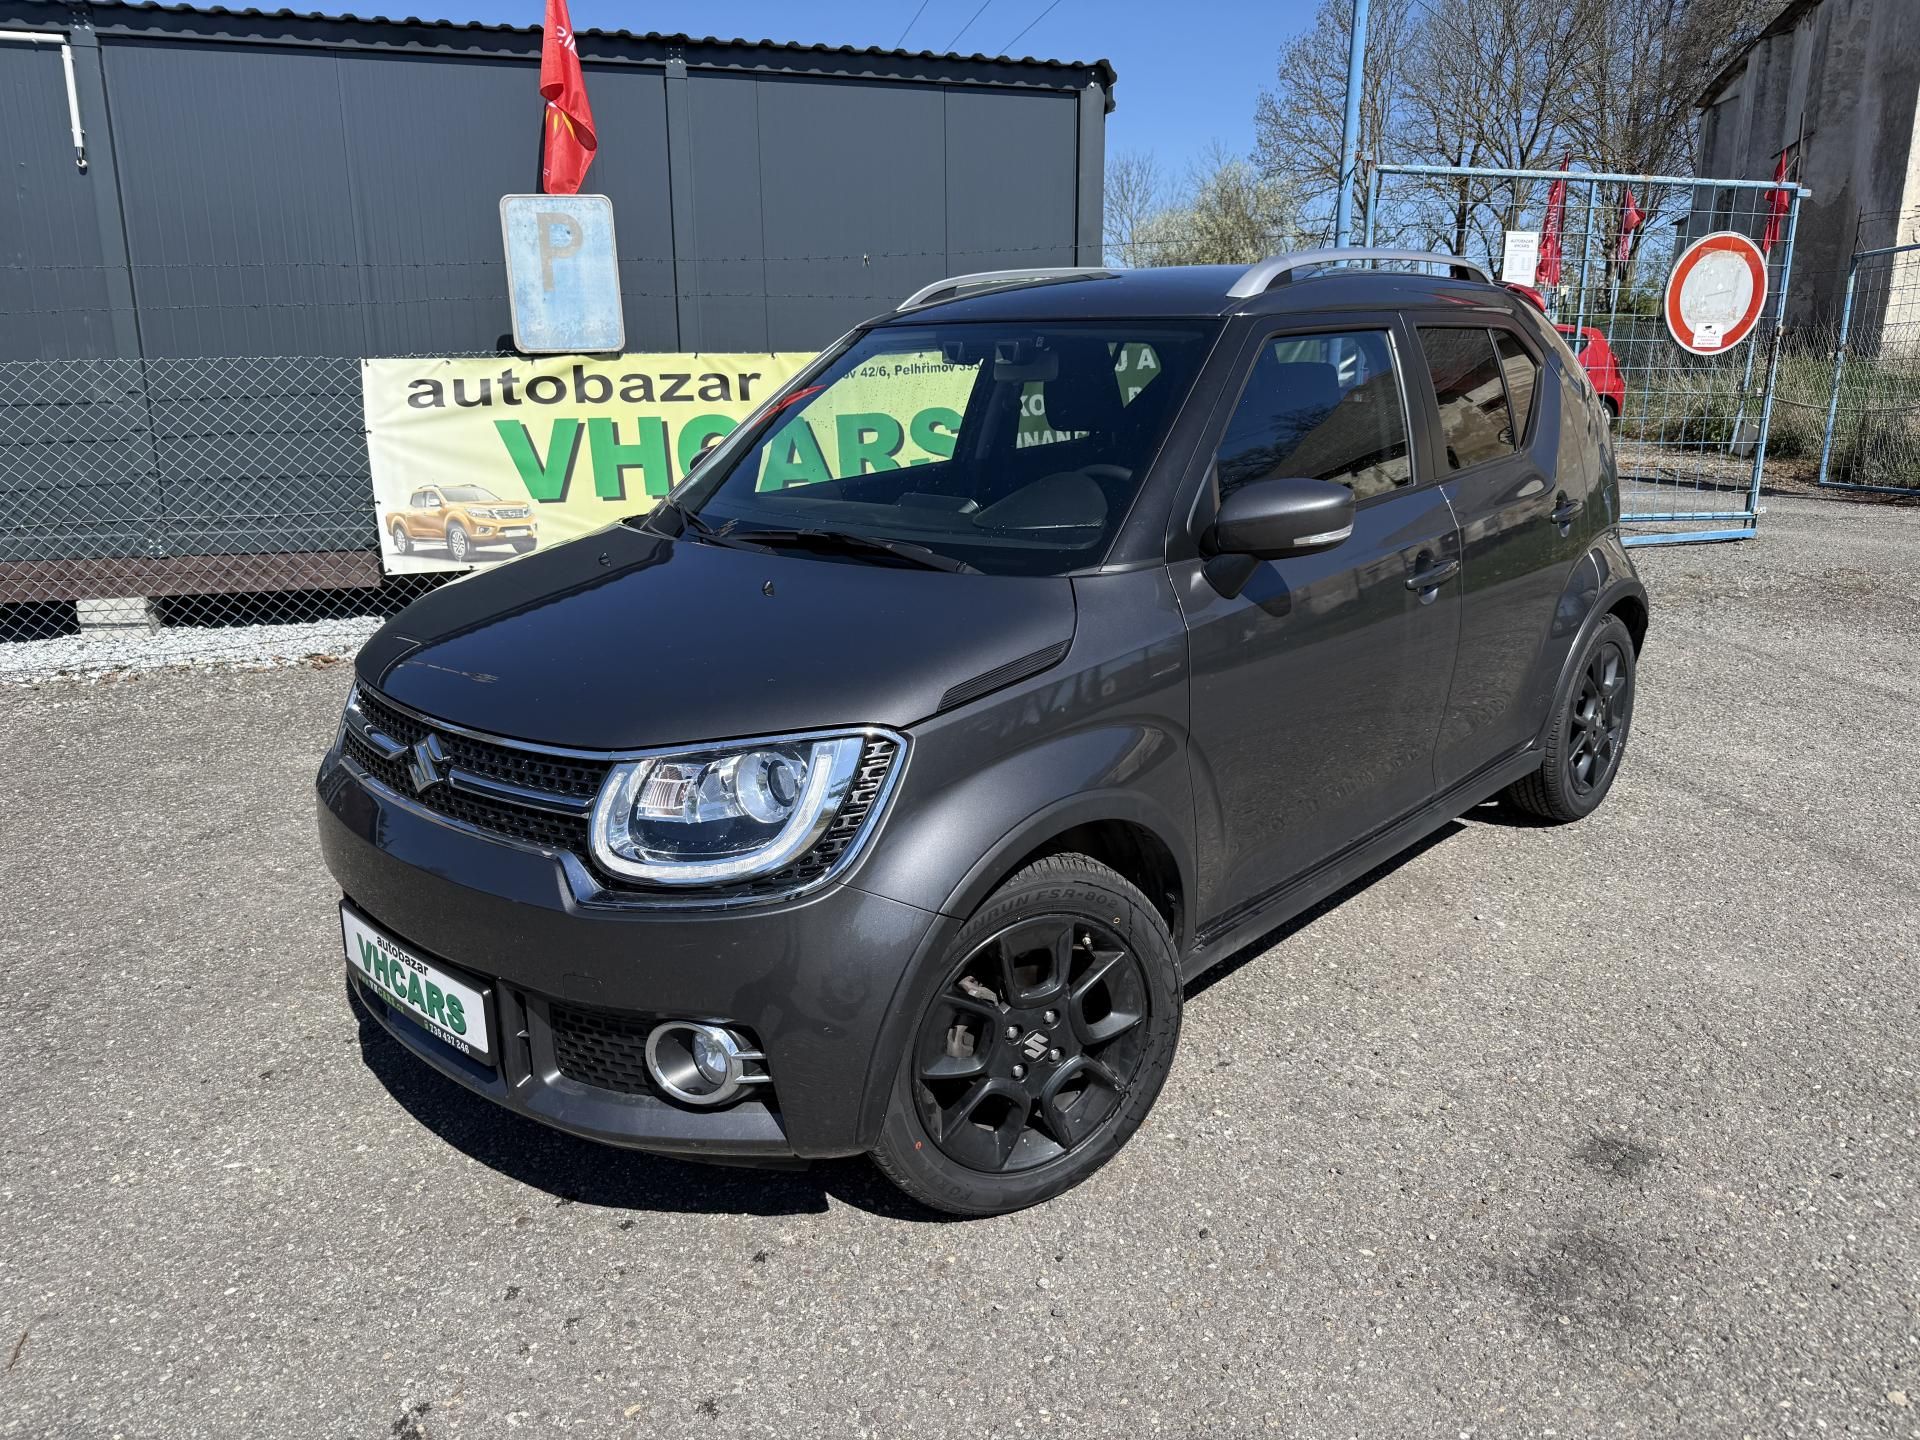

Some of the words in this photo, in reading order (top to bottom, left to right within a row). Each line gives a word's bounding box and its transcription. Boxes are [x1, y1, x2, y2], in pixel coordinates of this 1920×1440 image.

[535, 212, 584, 293] P
[406, 364, 762, 409] autobazar
[860, 366, 891, 380] 42/6,
[894, 361, 955, 376] Pelhřimov
[377, 935, 429, 977] autobazar
[356, 931, 467, 1036] VHCARS
